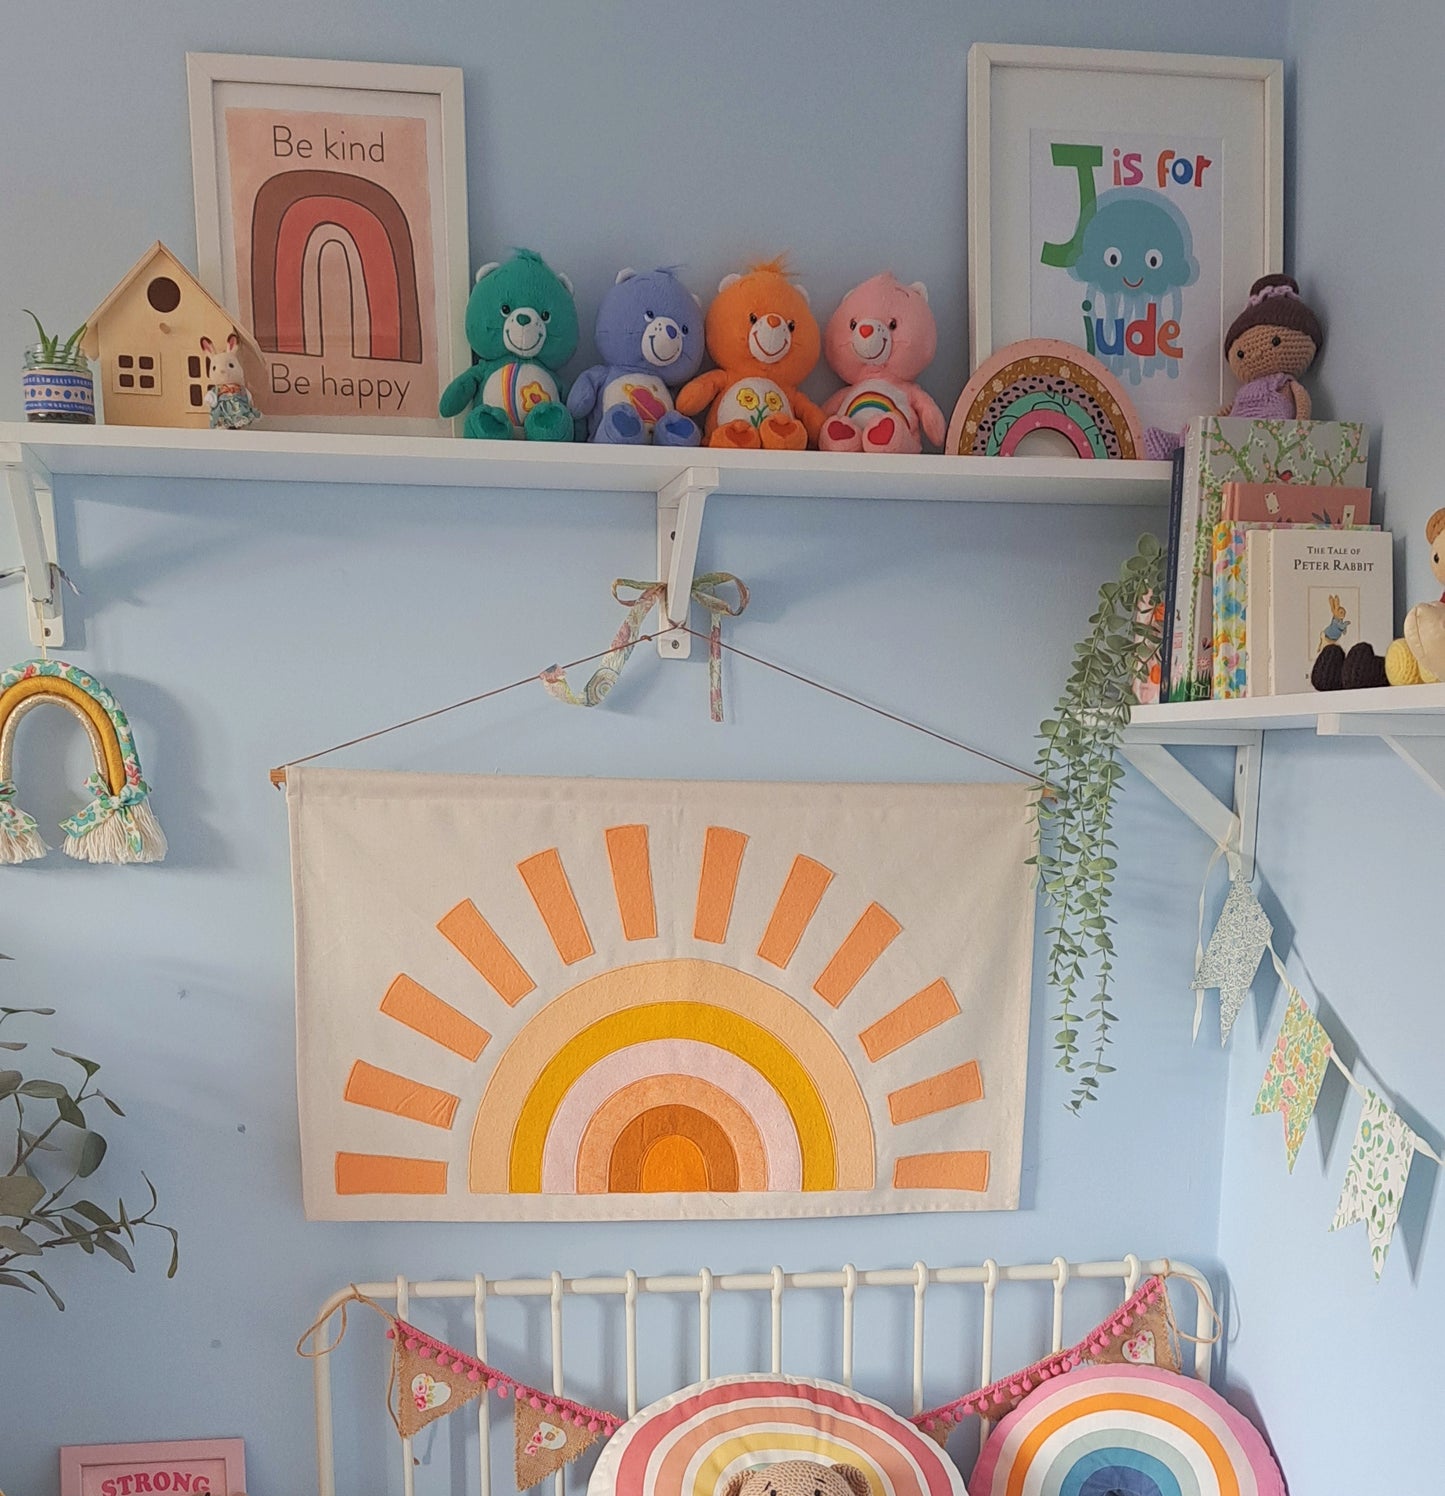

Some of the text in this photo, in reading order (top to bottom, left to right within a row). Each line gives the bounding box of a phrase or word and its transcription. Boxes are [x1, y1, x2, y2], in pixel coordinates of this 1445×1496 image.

[273, 125, 385, 163] Be kind
[1040, 143, 1212, 268] J is for
[271, 363, 410, 410] Be happy
